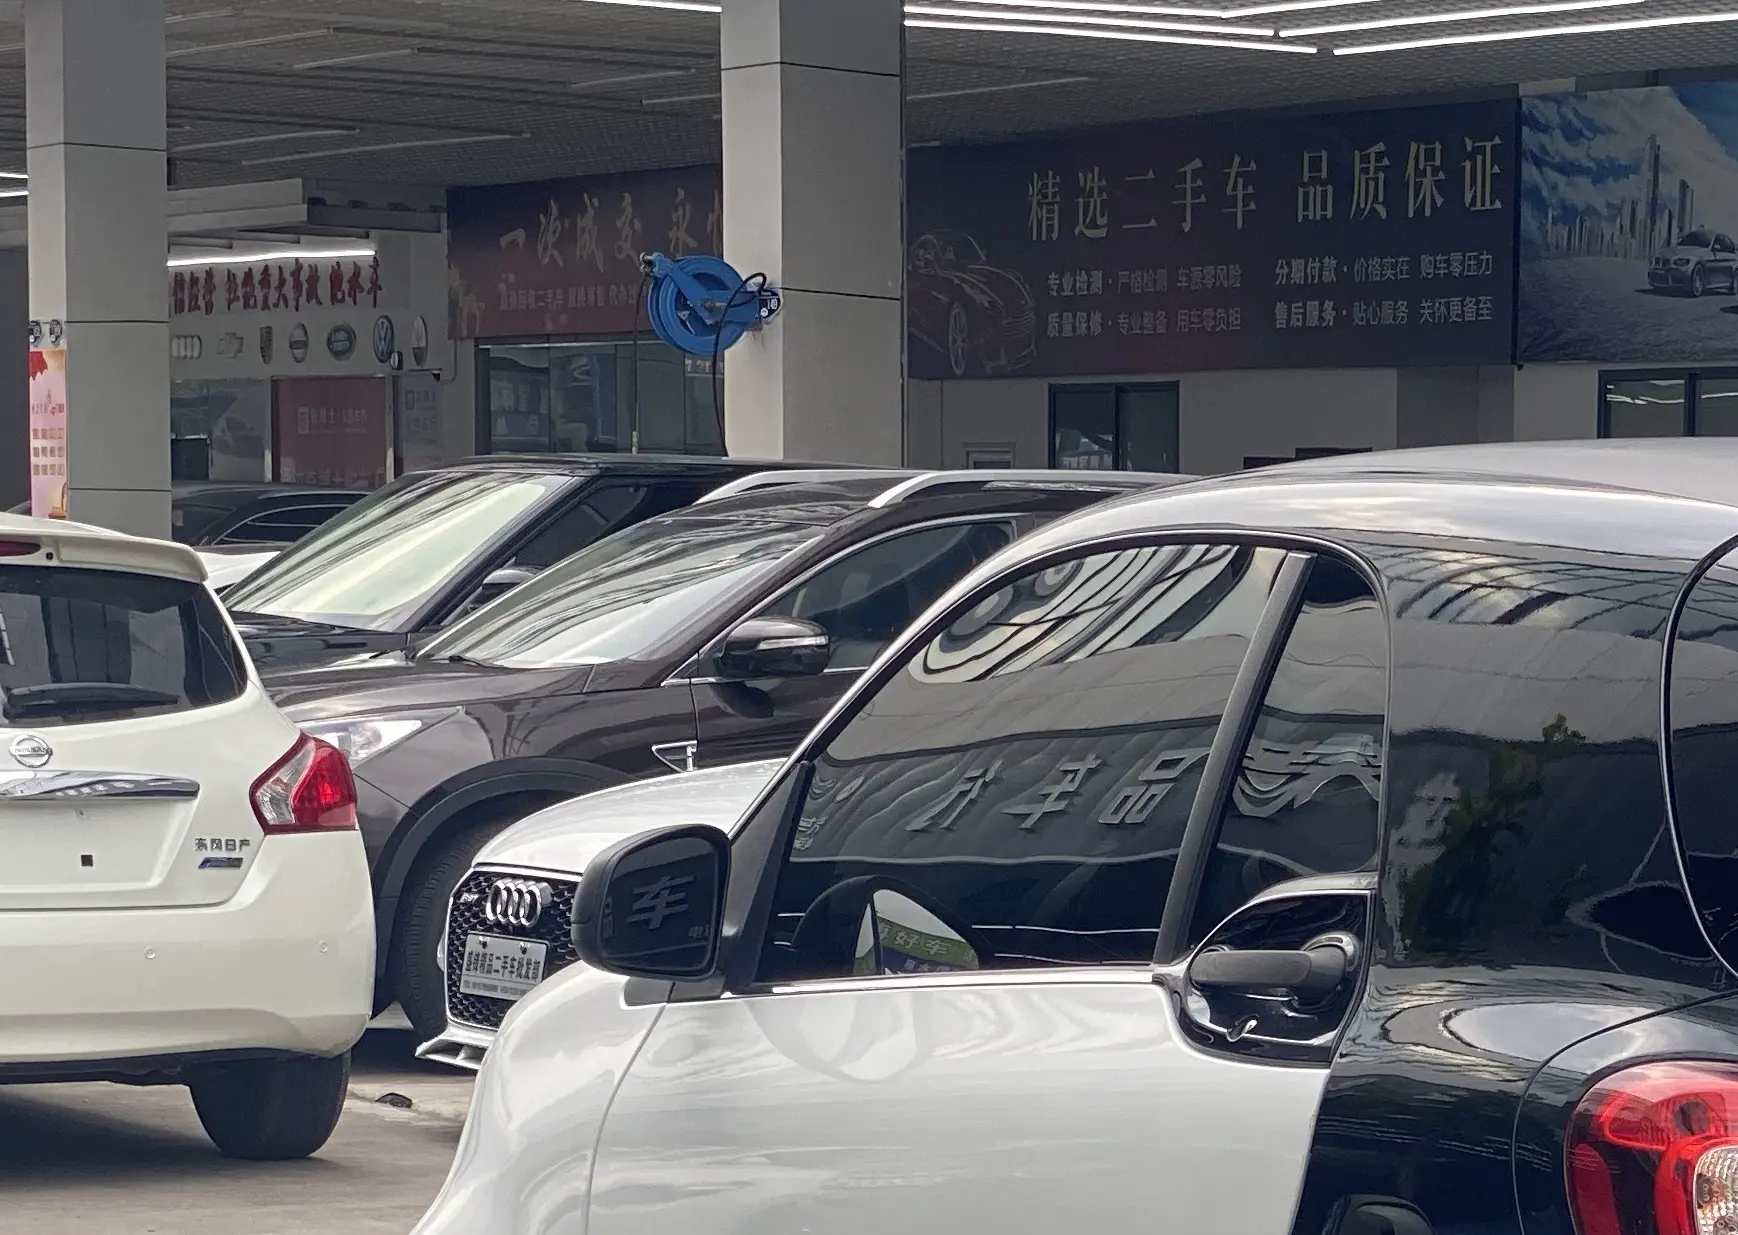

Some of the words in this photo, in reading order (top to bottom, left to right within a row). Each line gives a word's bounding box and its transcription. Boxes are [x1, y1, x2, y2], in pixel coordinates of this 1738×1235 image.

[1027, 154, 1257, 241] 精选二手车
[1297, 134, 1502, 222] 品质保证
[1420, 249, 1493, 279] 购车零压力
[1176, 307, 1242, 333] 用车零负担
[1419, 296, 1493, 324] 关怀更备至
[195, 838, 250, 853] 东风日产
